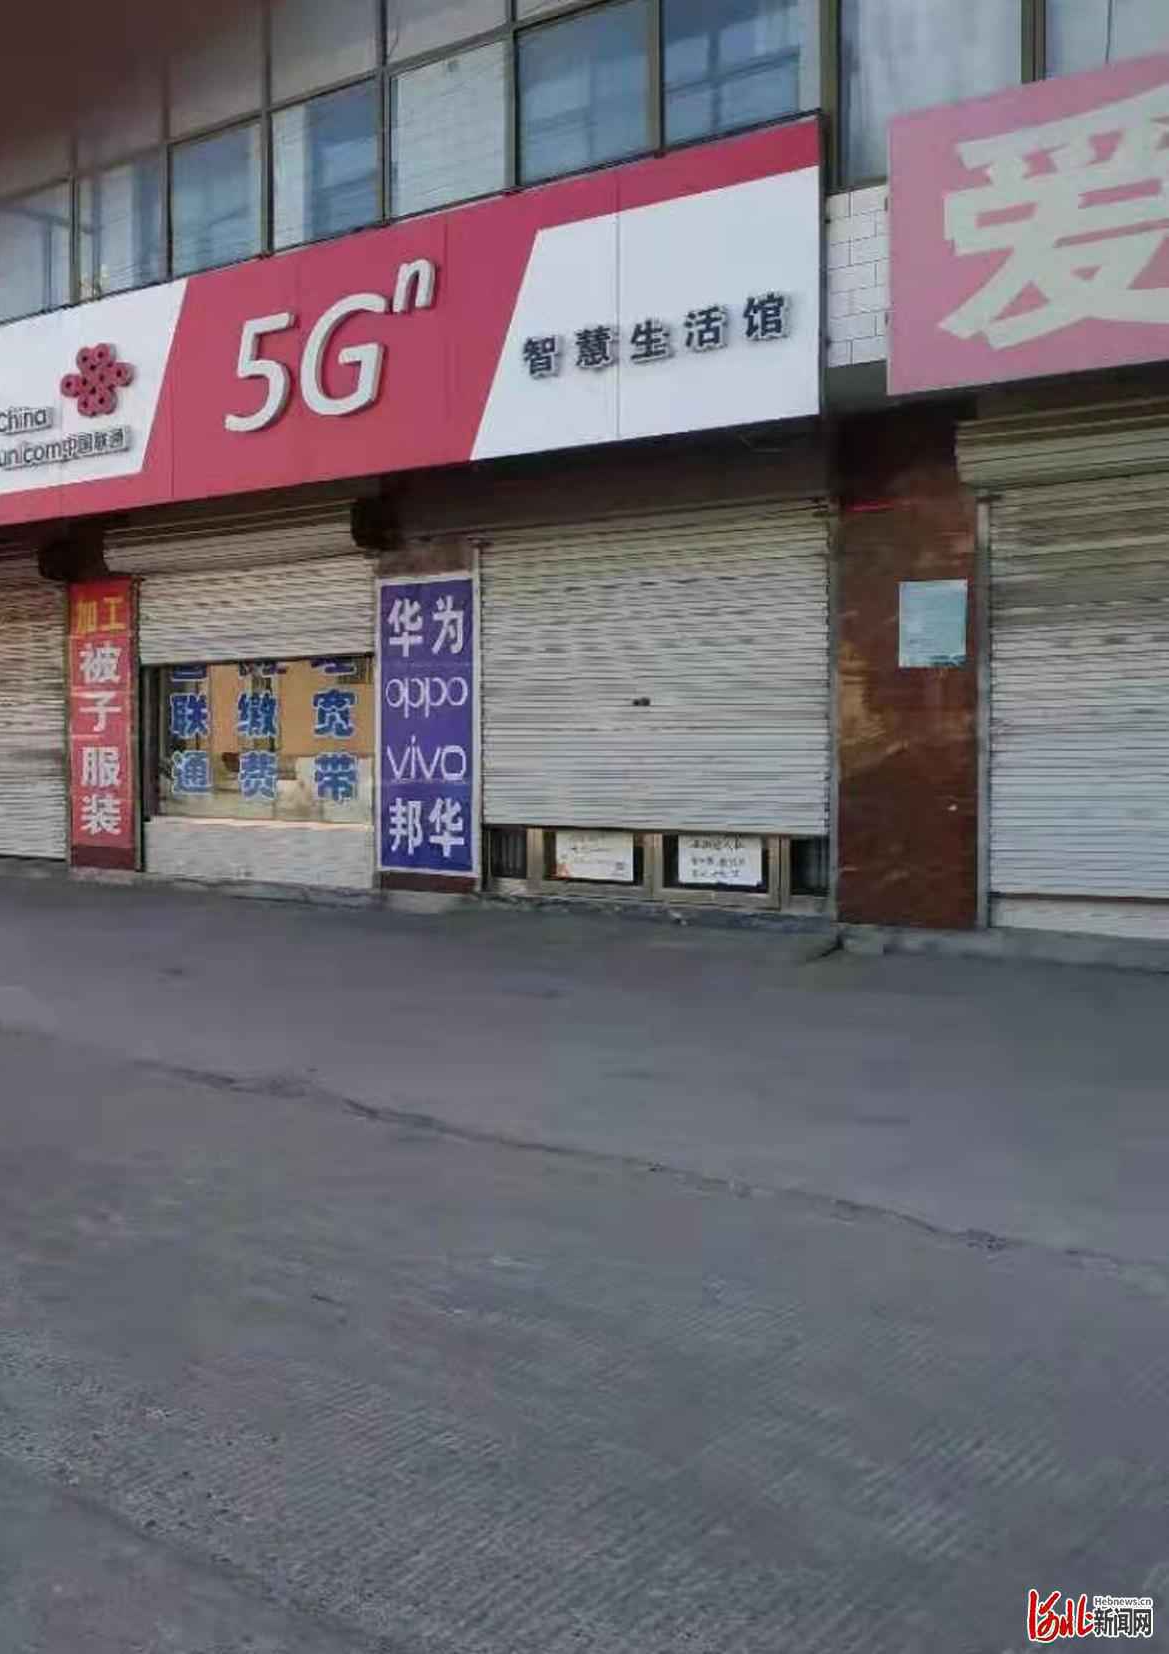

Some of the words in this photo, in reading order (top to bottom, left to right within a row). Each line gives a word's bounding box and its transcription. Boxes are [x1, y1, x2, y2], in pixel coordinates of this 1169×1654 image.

[941, 80, 1169, 350] 爱
[522, 293, 788, 379] 智慧生活馆
[387, 595, 465, 657] 华为
[79, 641, 122, 836] 被子服装
[386, 735, 467, 781] vivo
[388, 797, 465, 858] 邦华
